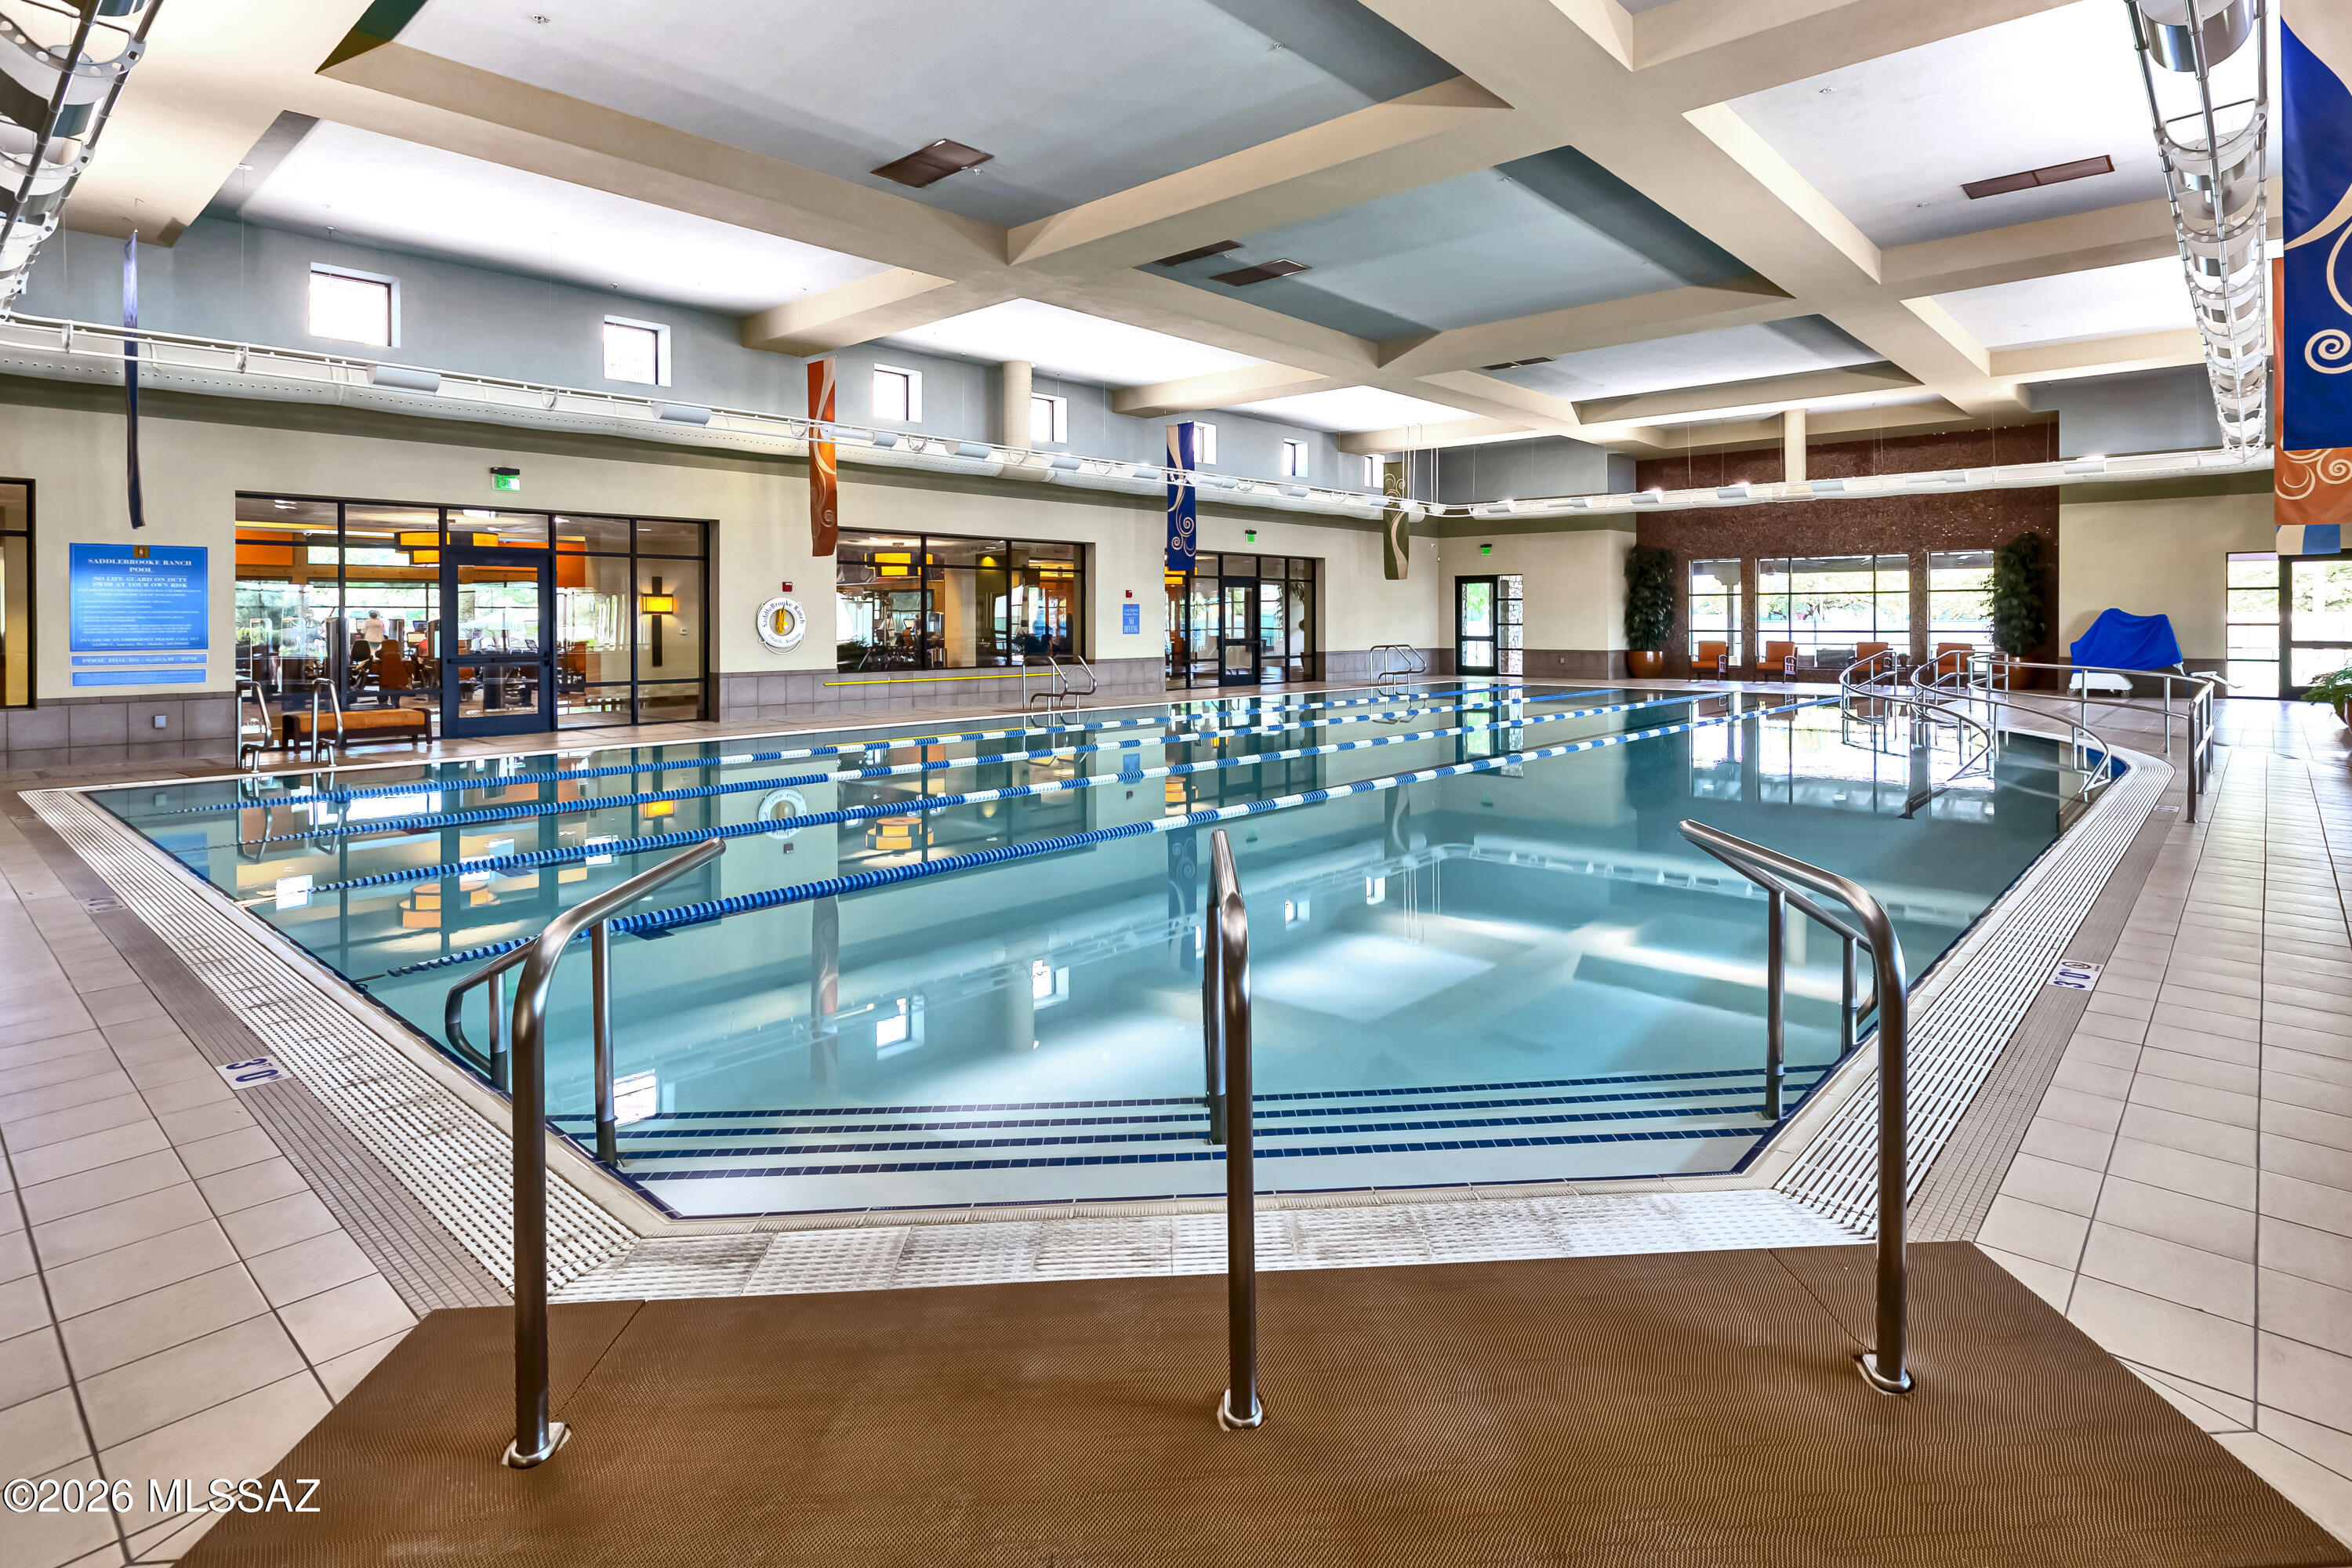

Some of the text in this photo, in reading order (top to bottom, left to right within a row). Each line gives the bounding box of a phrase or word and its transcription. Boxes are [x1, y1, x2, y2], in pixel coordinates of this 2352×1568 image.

[763, 600, 805, 627] SaddleBrooke Ranch
[226, 1058, 267, 1069] 3
[235, 1069, 278, 1082] 0
